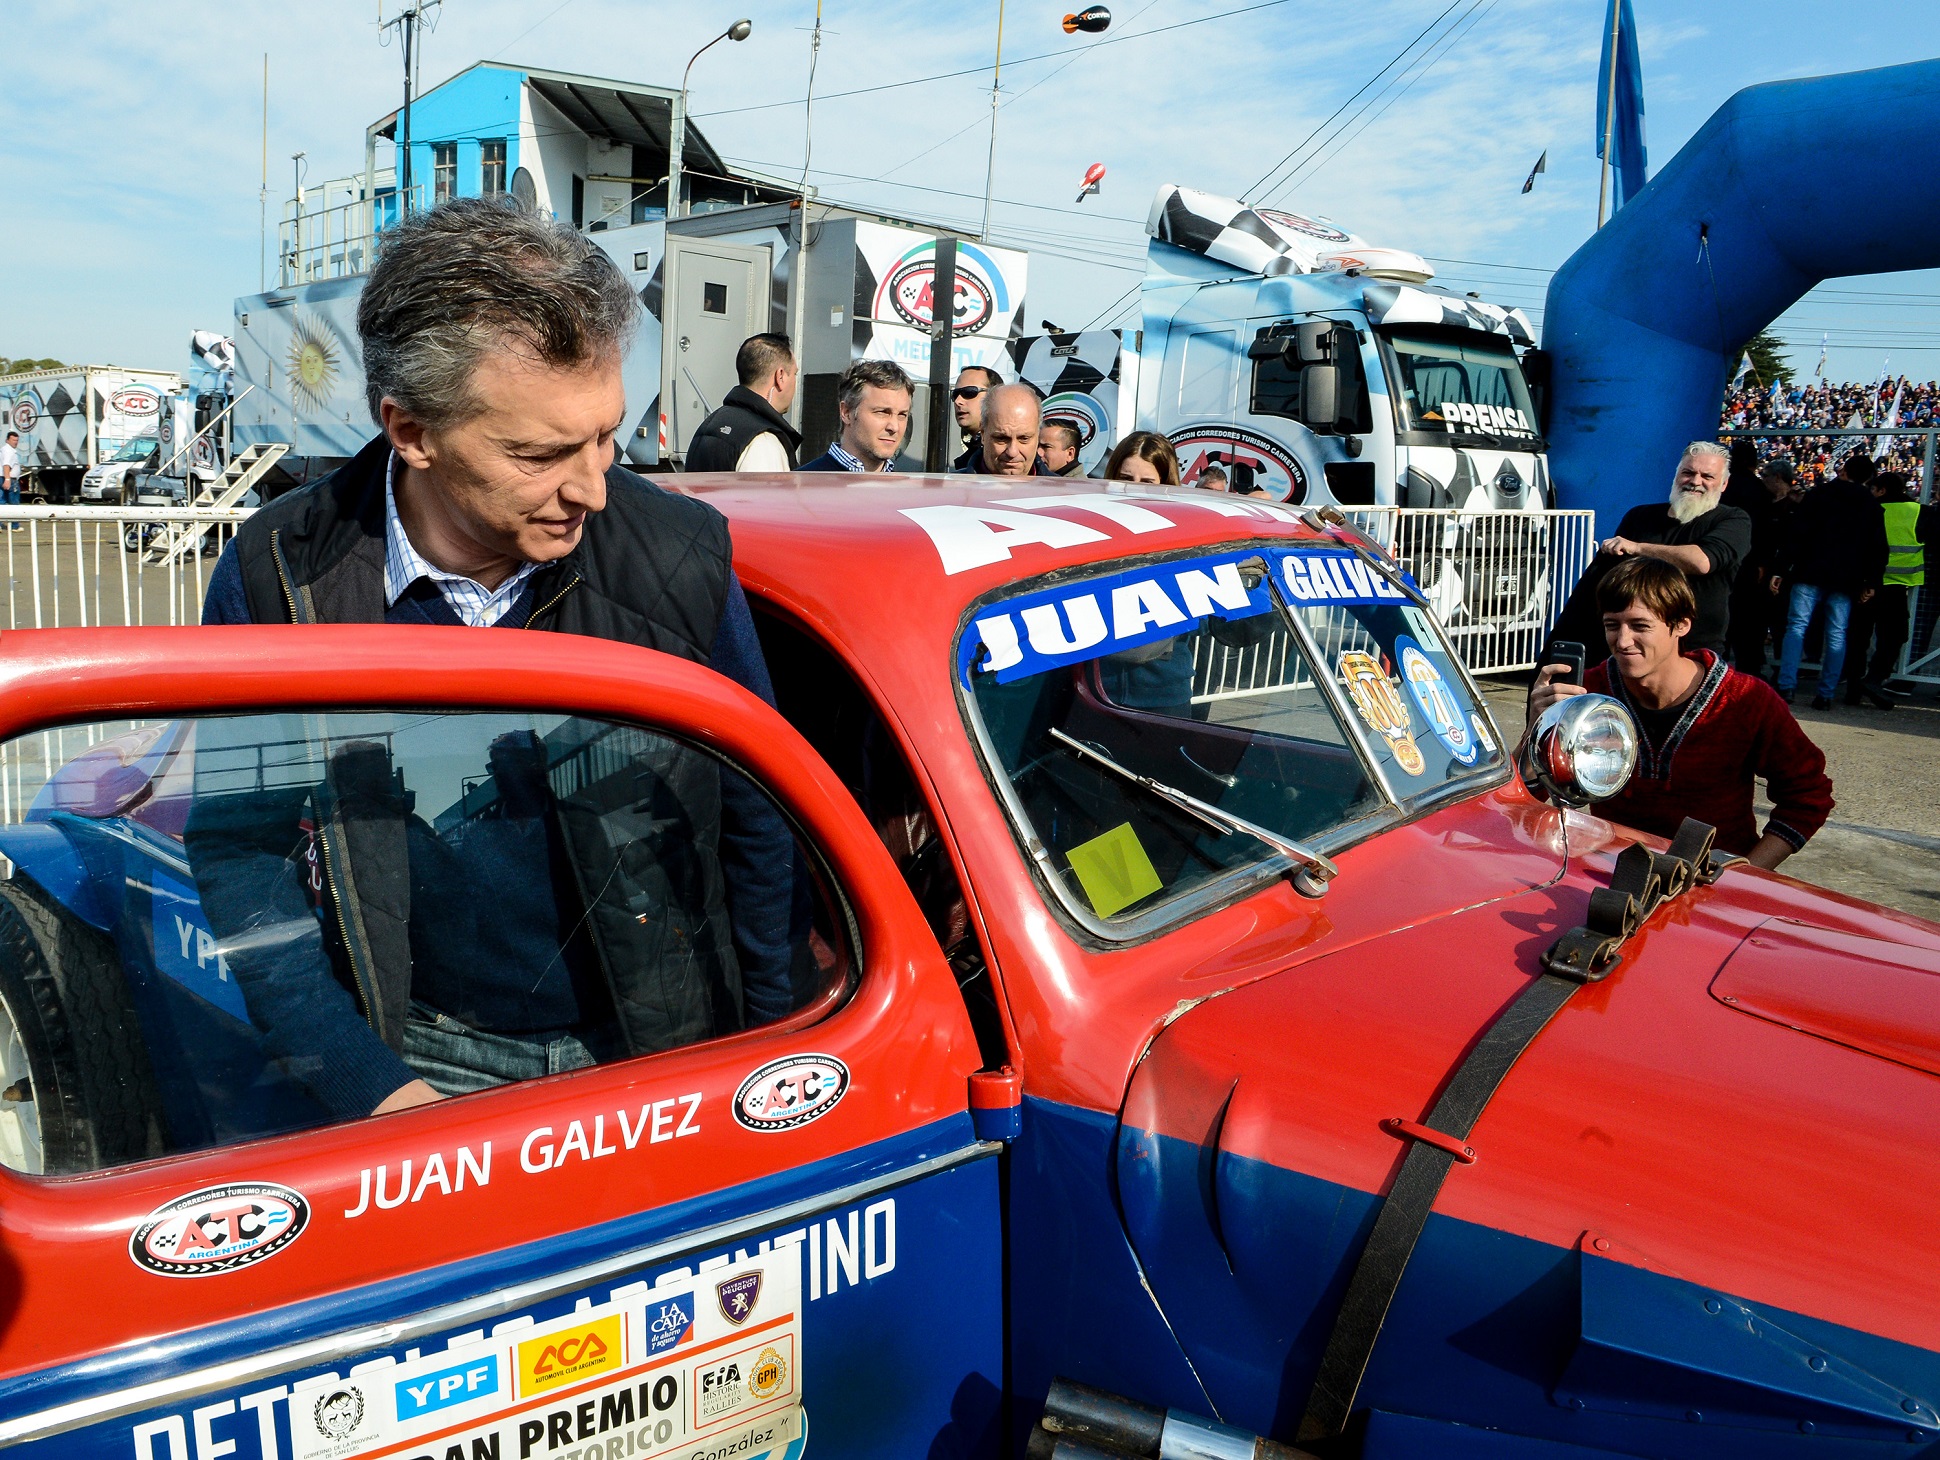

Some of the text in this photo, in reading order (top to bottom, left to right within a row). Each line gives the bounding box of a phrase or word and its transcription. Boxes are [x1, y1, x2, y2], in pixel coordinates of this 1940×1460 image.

[1441, 402, 1534, 440] PRENSA
[1196, 430, 1241, 439] CORREDORES
[1242, 434, 1270, 451] TURISMO
[1271, 447, 1303, 484] CARRETERA
[975, 562, 1251, 672] JUAN
[1361, 678, 1400, 729] 80
[761, 1060, 793, 1077] CORREDORES
[762, 1071, 822, 1115] ACTC
[771, 1100, 817, 1117] ARGENTINA
[344, 1092, 703, 1218] JUAN GALVEZ
[177, 1191, 225, 1213] CORREDORES
[227, 1187, 260, 1197] TURISMO
[261, 1188, 301, 1208] CARRETERA
[173, 1204, 267, 1257] ACTC
[188, 1238, 259, 1259] ARGENTINA
[723, 1281, 757, 1296] PEUGEOT
[651, 1312, 689, 1332] CAJA
[660, 1302, 681, 1319] LA
[651, 1328, 681, 1343] de ahorro
[657, 1335, 676, 1347] seguro
[533, 1332, 607, 1375] ACA
[535, 1356, 606, 1384] AUTOMOVIL CLUB ARGENTINO
[757, 1366, 777, 1385] GPH
[406, 1365, 489, 1408] YPF
[703, 1382, 742, 1401] HISTORIC
[519, 1375, 678, 1460] PREMIO
[703, 1395, 742, 1416] RALLIES
[303, 1446, 332, 1460] GOBIERNO
[333, 1443, 340, 1451] DE
[350, 1433, 380, 1446] PROVINCIA
[325, 1445, 359, 1460] DE SAN LUIS
